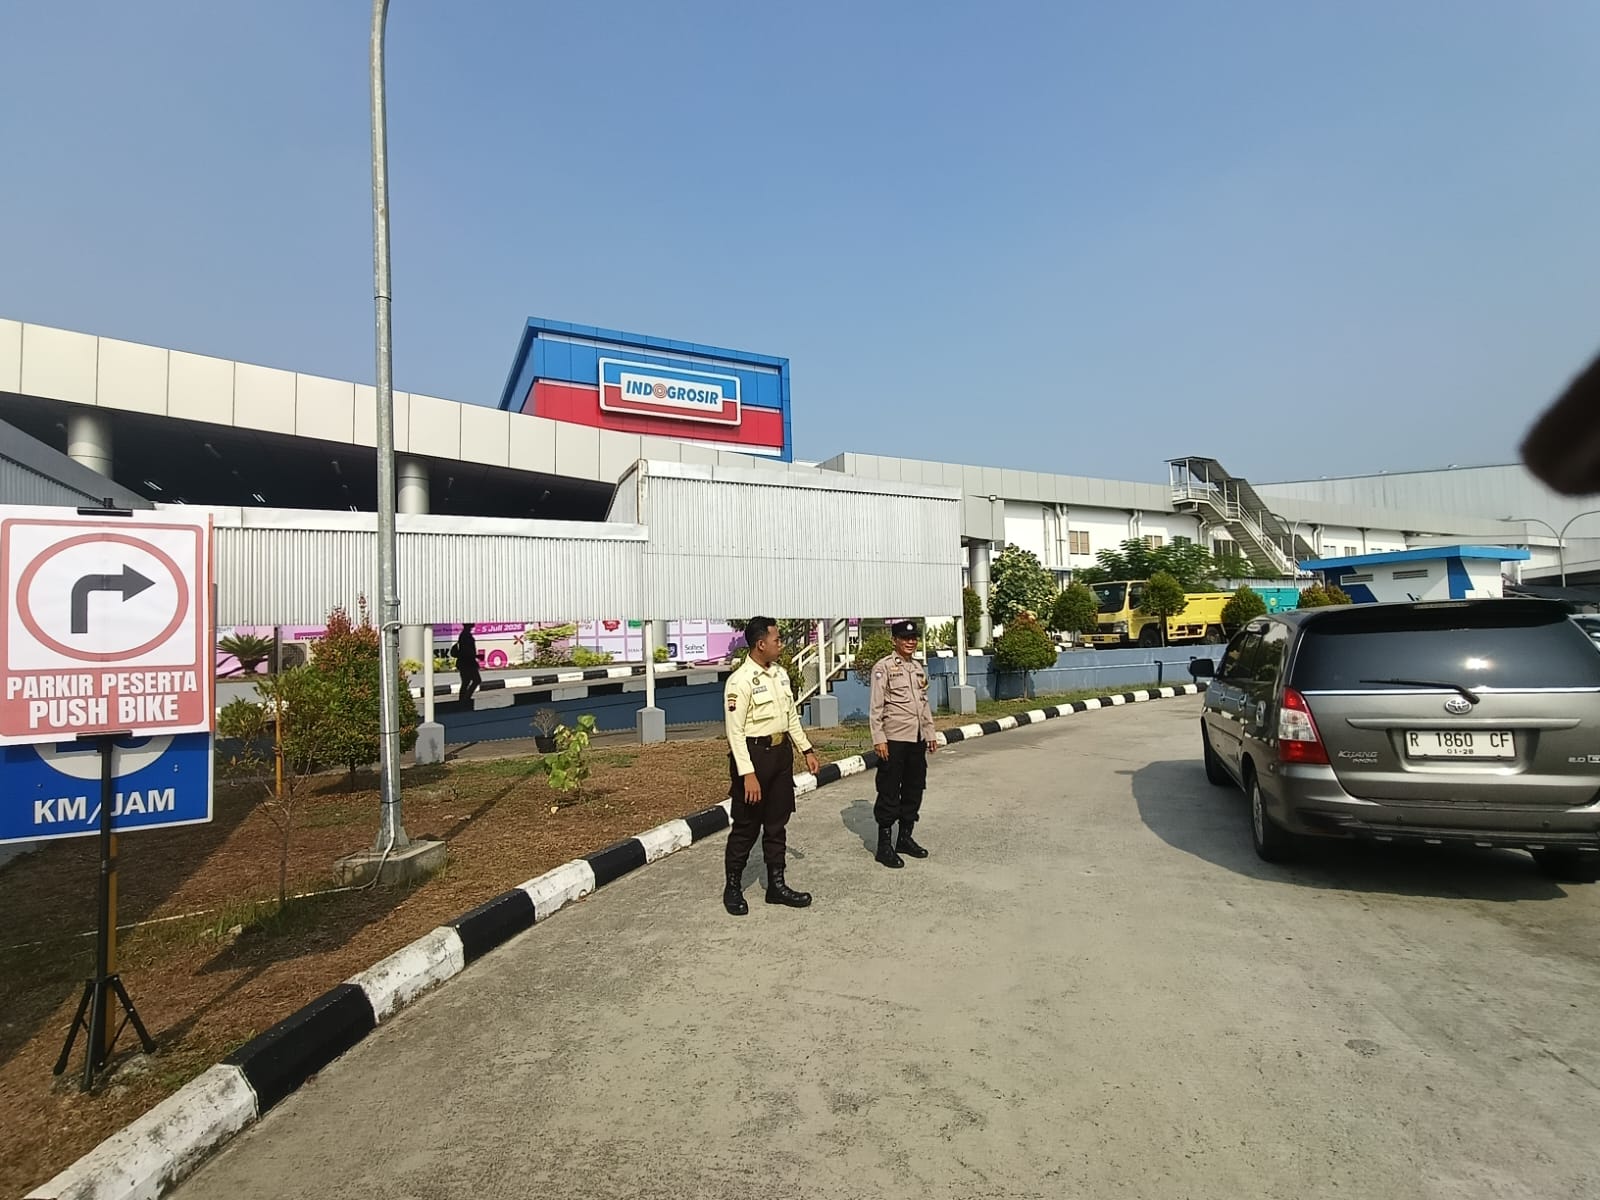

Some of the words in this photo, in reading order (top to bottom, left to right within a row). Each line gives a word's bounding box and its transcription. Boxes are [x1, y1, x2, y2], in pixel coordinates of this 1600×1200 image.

[625, 380, 719, 405] INDOGROSIR
[6, 674, 94, 700] PARKIR
[101, 670, 198, 696] PESERTA
[29, 697, 109, 729] PUSH
[118, 694, 179, 724] BIKE
[1409, 732, 1419, 747] R
[1435, 732, 1474, 748] 1860
[1489, 732, 1510, 748] CF
